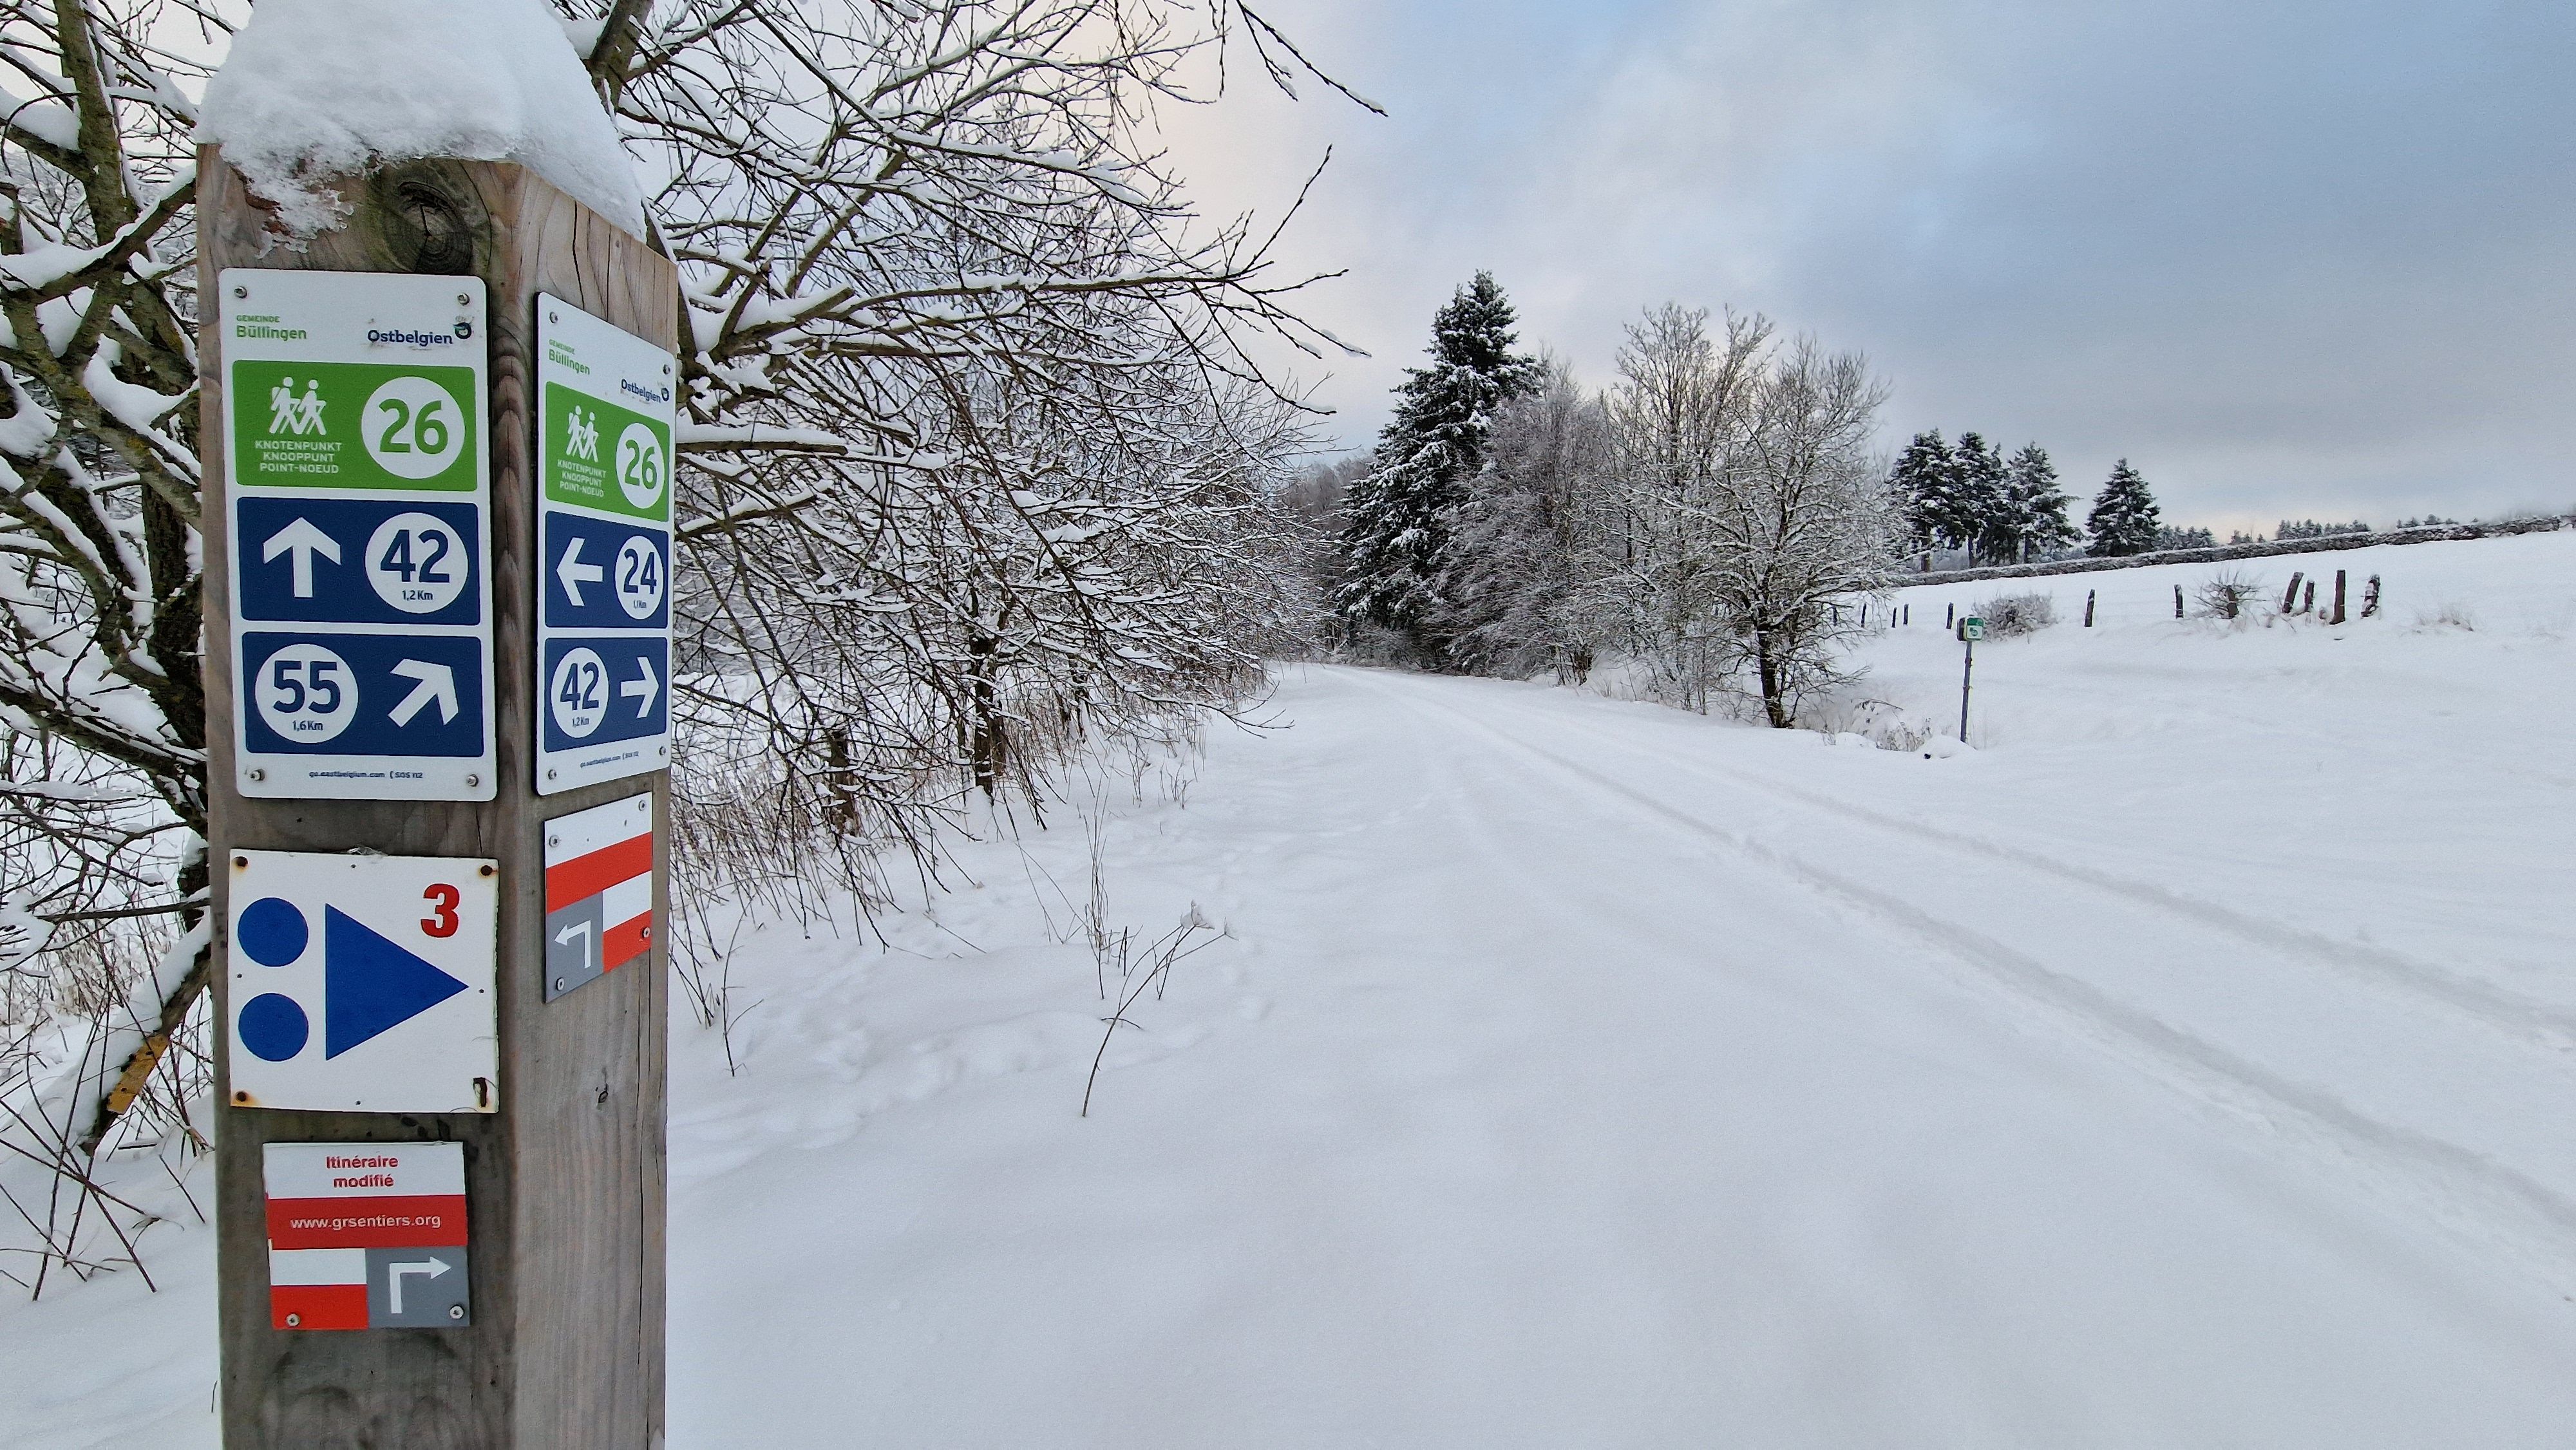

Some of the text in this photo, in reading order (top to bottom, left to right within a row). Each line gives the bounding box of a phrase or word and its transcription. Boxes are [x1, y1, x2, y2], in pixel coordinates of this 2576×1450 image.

[236, 325, 307, 341] Büllingen
[368, 329, 453, 347] Ostbelgien
[549, 348, 591, 375] Büllingen
[621, 378, 661, 403] Ostbelgien
[379, 398, 448, 455] 26
[255, 440, 342, 451] KNOTENPUNKT
[263, 451, 334, 462] KNOOPPUNT
[625, 438, 658, 490] 26
[260, 462, 339, 474] POINT-NOEUD
[557, 459, 607, 478] KNOTENPUNKT
[562, 469, 602, 487] KNOOPPUNT
[560, 480, 604, 498] POINT-NOEUD
[380, 529, 450, 583] 42
[623, 548, 657, 595] 24
[273, 660, 341, 714] 55
[560, 661, 600, 711] 42
[420, 883, 460, 938] 3
[326, 1155, 399, 1169] Itinéraire
[334, 1174, 395, 1188] modifié
[290, 1215, 442, 1230] www.grsentiers.org
